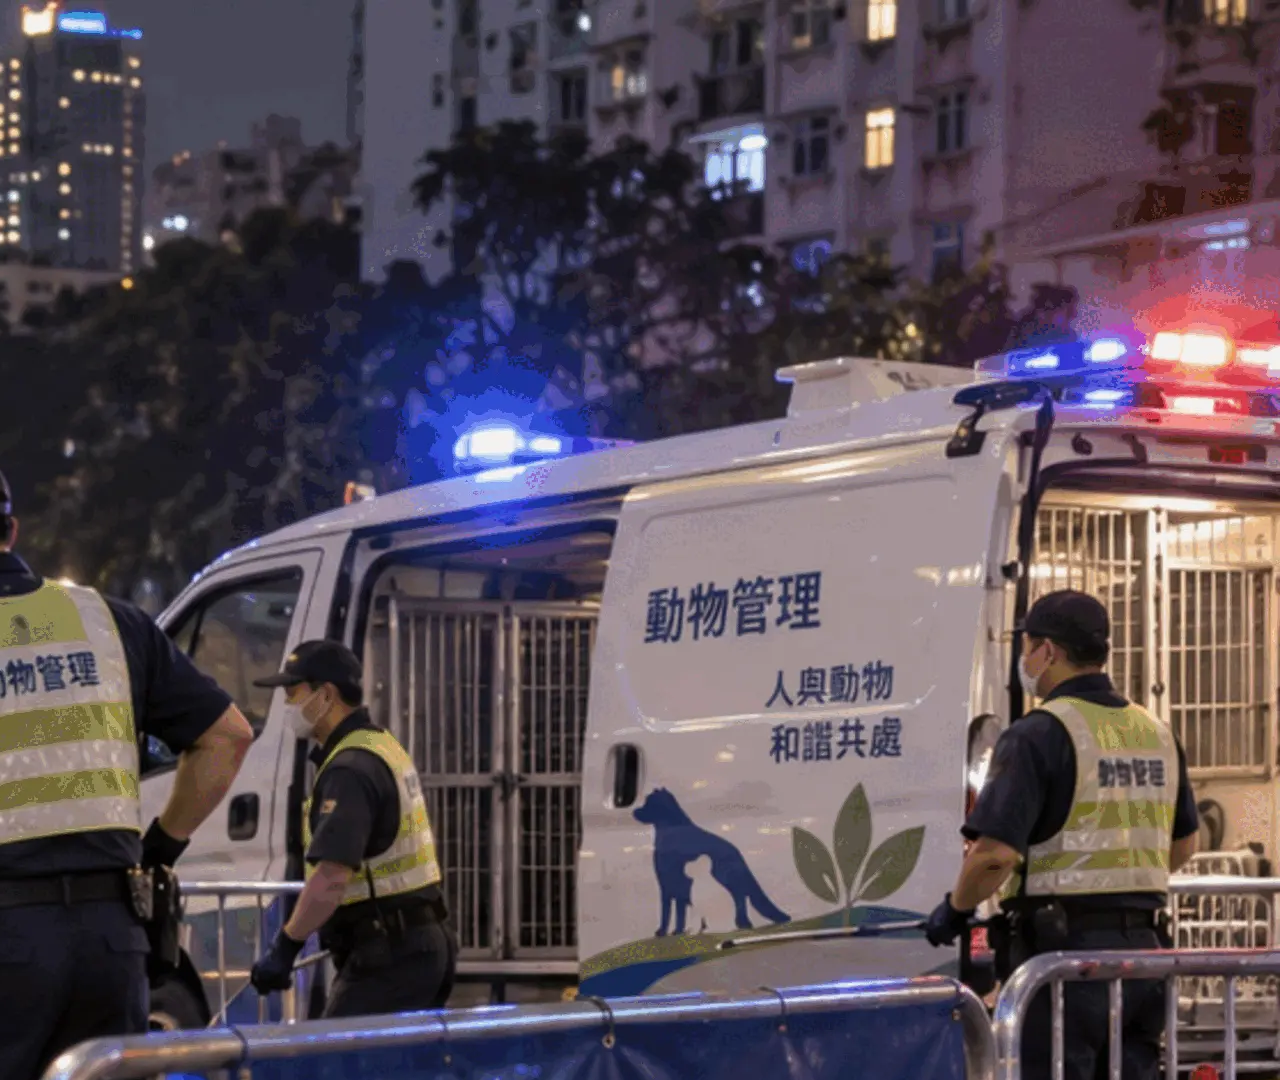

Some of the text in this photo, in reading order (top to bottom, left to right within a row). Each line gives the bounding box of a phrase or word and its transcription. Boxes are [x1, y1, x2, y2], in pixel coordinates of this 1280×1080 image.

[644, 571, 822, 644] 動物管理
[769, 716, 902, 764] 和諧共處
